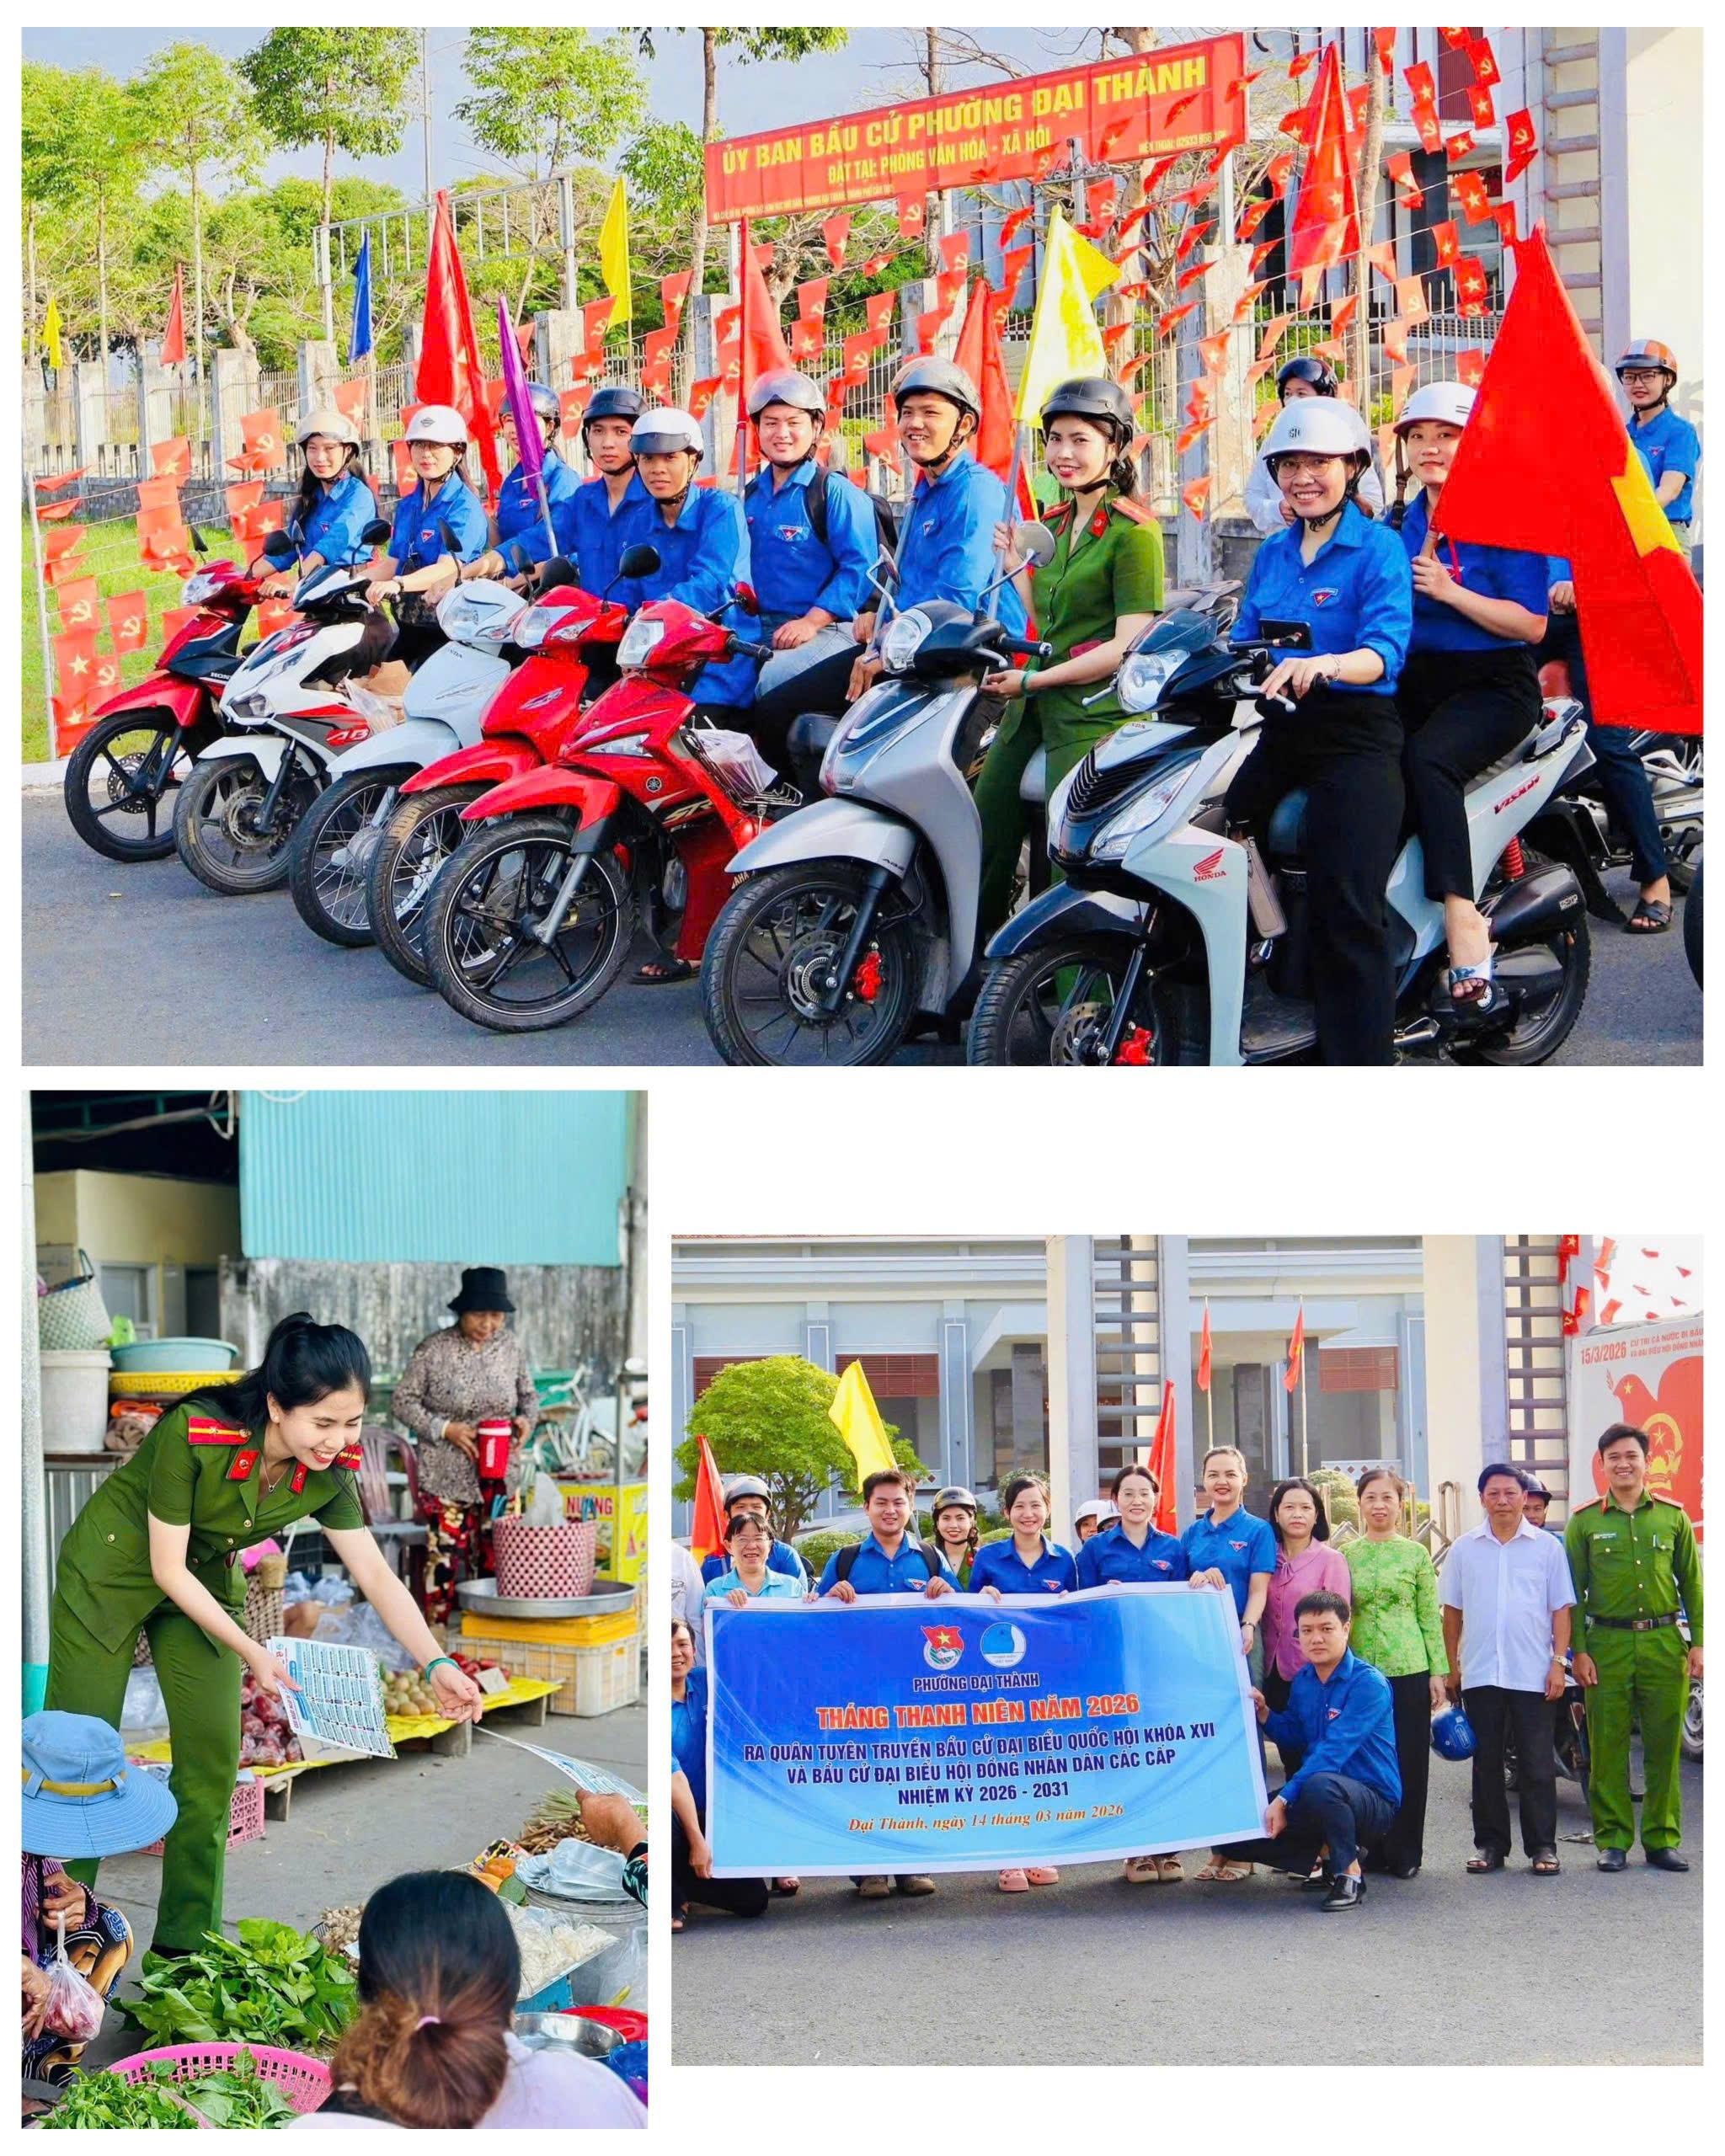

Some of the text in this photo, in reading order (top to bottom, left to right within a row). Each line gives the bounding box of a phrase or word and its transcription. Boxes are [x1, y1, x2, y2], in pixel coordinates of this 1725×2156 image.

[723, 56, 1206, 174] ỦY BAN BẦU CỬ PHƯỜNG ĐẠI THÀNH
[881, 147, 925, 175] PHÒNG
[959, 138, 986, 162] HÓA
[1002, 129, 1022, 155] XÃ
[1025, 124, 1051, 152] HỘI
[1193, 871, 1227, 883] HONDA
[1580, 1342, 1626, 1365] 15/3/2026
[913, 1671, 1039, 1692] PHƯỜNG ĐẠI THÀNH
[816, 1693, 1140, 1730] THÁNG THANH NIÊN NĂM 2026
[744, 1722, 1215, 1763] RA QUÂN TUYÊN TRUYỀN BẦU CỬ ĐẠI BIỂU QUỐC HỘI KHÓA XVI
[787, 1744, 1176, 1785] VÀ BẦU CỬ ĐẠI BIỂU HỘI ĐỒNG NHÂN DÂN CÁC CẤP
[898, 1785, 949, 1807] NHIỆM
[954, 1782, 974, 1803] KỲ
[979, 1785, 1017, 1801] 2026
[1033, 1780, 1069, 1798] 2031
[879, 1816, 928, 1830] Thành,
[932, 1814, 967, 1831] ngày
[970, 1813, 987, 1827] 14
[991, 1812, 1031, 1827] tháng
[1035, 1809, 1052, 1822] 03
[1055, 1808, 1087, 1822] năm
[1091, 1805, 1124, 1818] 2026
